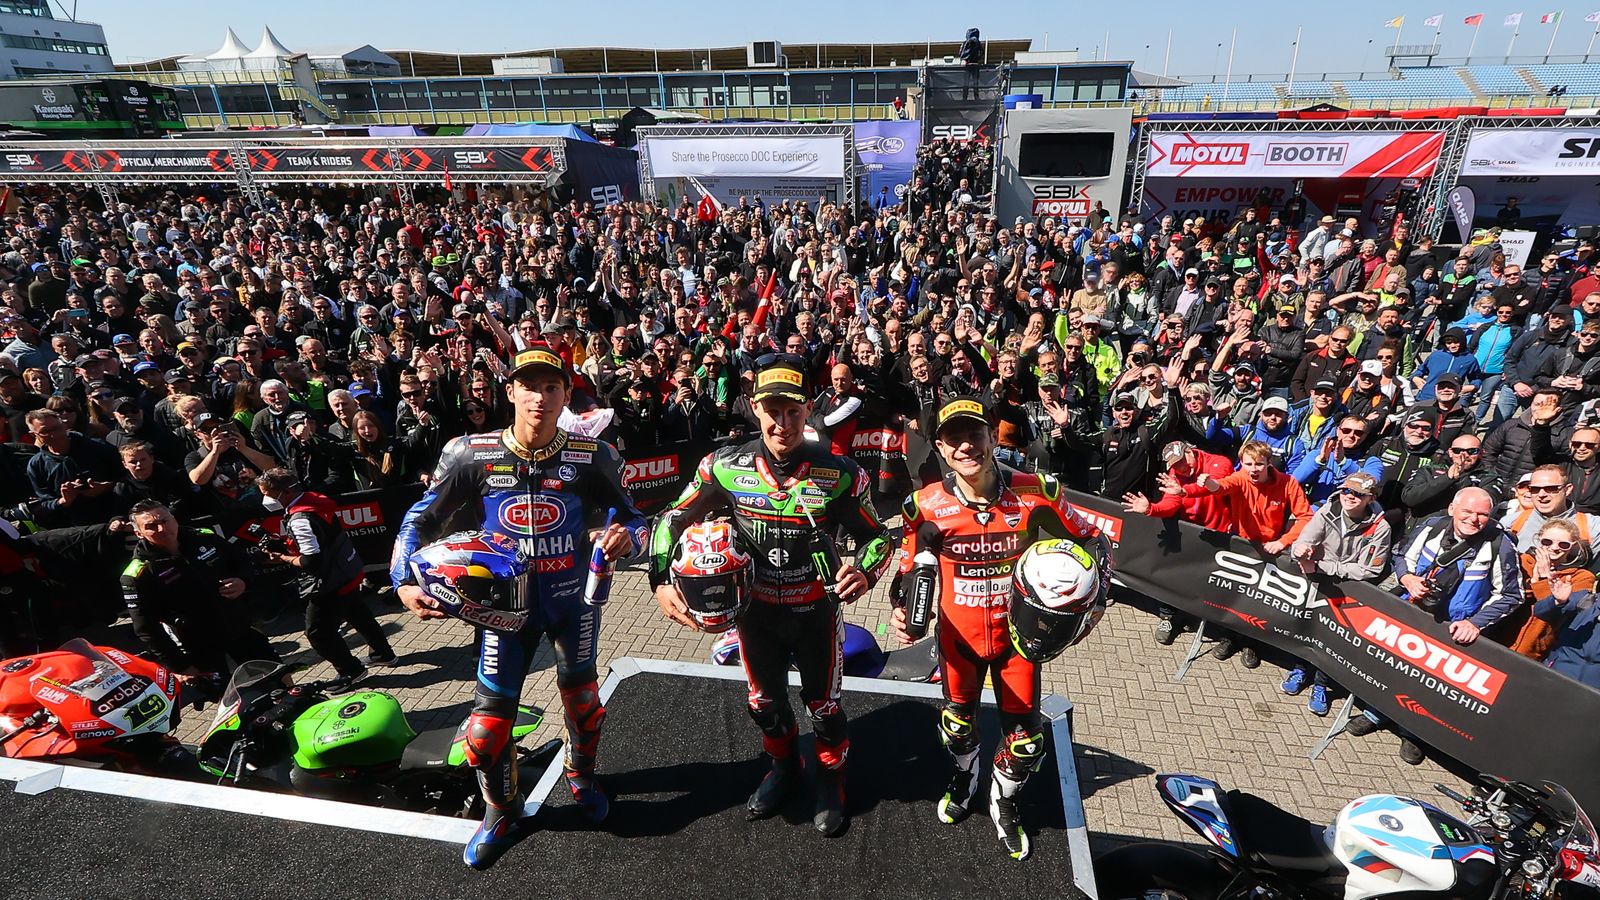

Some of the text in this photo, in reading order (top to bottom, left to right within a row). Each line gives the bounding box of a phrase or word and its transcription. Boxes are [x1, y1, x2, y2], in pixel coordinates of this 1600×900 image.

[34, 105, 74, 114] Kawasaki
[932, 124, 989, 140] SBK
[6, 154, 42, 166] SBK
[286, 156, 352, 166] TEAM & RIDERS
[454, 152, 496, 163] SBK
[672, 151, 818, 164] Share the Prosecco DOC Experience
[1173, 146, 1344, 162] MOTUL BOOTH
[118, 157, 212, 168] OFFICIAL MERCHANDISE
[1033, 184, 1094, 198] SBK
[1034, 201, 1088, 215] MOTUL
[543, 430, 567, 458] YAMAHA
[852, 432, 903, 448] MOTU
[624, 458, 676, 480] OTUL
[736, 476, 756, 485] Arai
[738, 496, 756, 505] elf
[512, 508, 552, 521] PATA
[934, 504, 960, 518] FIAMM
[518, 534, 574, 557] MAHA
[952, 534, 1019, 554] aruba.it
[696, 555, 724, 566] Arai
[960, 564, 1010, 577] Lenovo
[434, 586, 458, 603] SHOEI
[970, 581, 999, 593] riello
[1210, 550, 1356, 628] SBK
[460, 604, 522, 629] Red Bull
[576, 610, 594, 664] YAMAHA
[484, 630, 498, 674] MAHA
[1208, 575, 1490, 716] FIM SUPERBIKE WORLD CHAMPIONSHIP
[1273, 626, 1388, 692] WE MAKE EXCITEMENT
[1364, 616, 1496, 696] MOTUL
[36, 686, 69, 704] FIAMM
[123, 694, 168, 732] 19
[74, 730, 116, 739] Lenovo
[318, 726, 360, 743] Kawasaki
